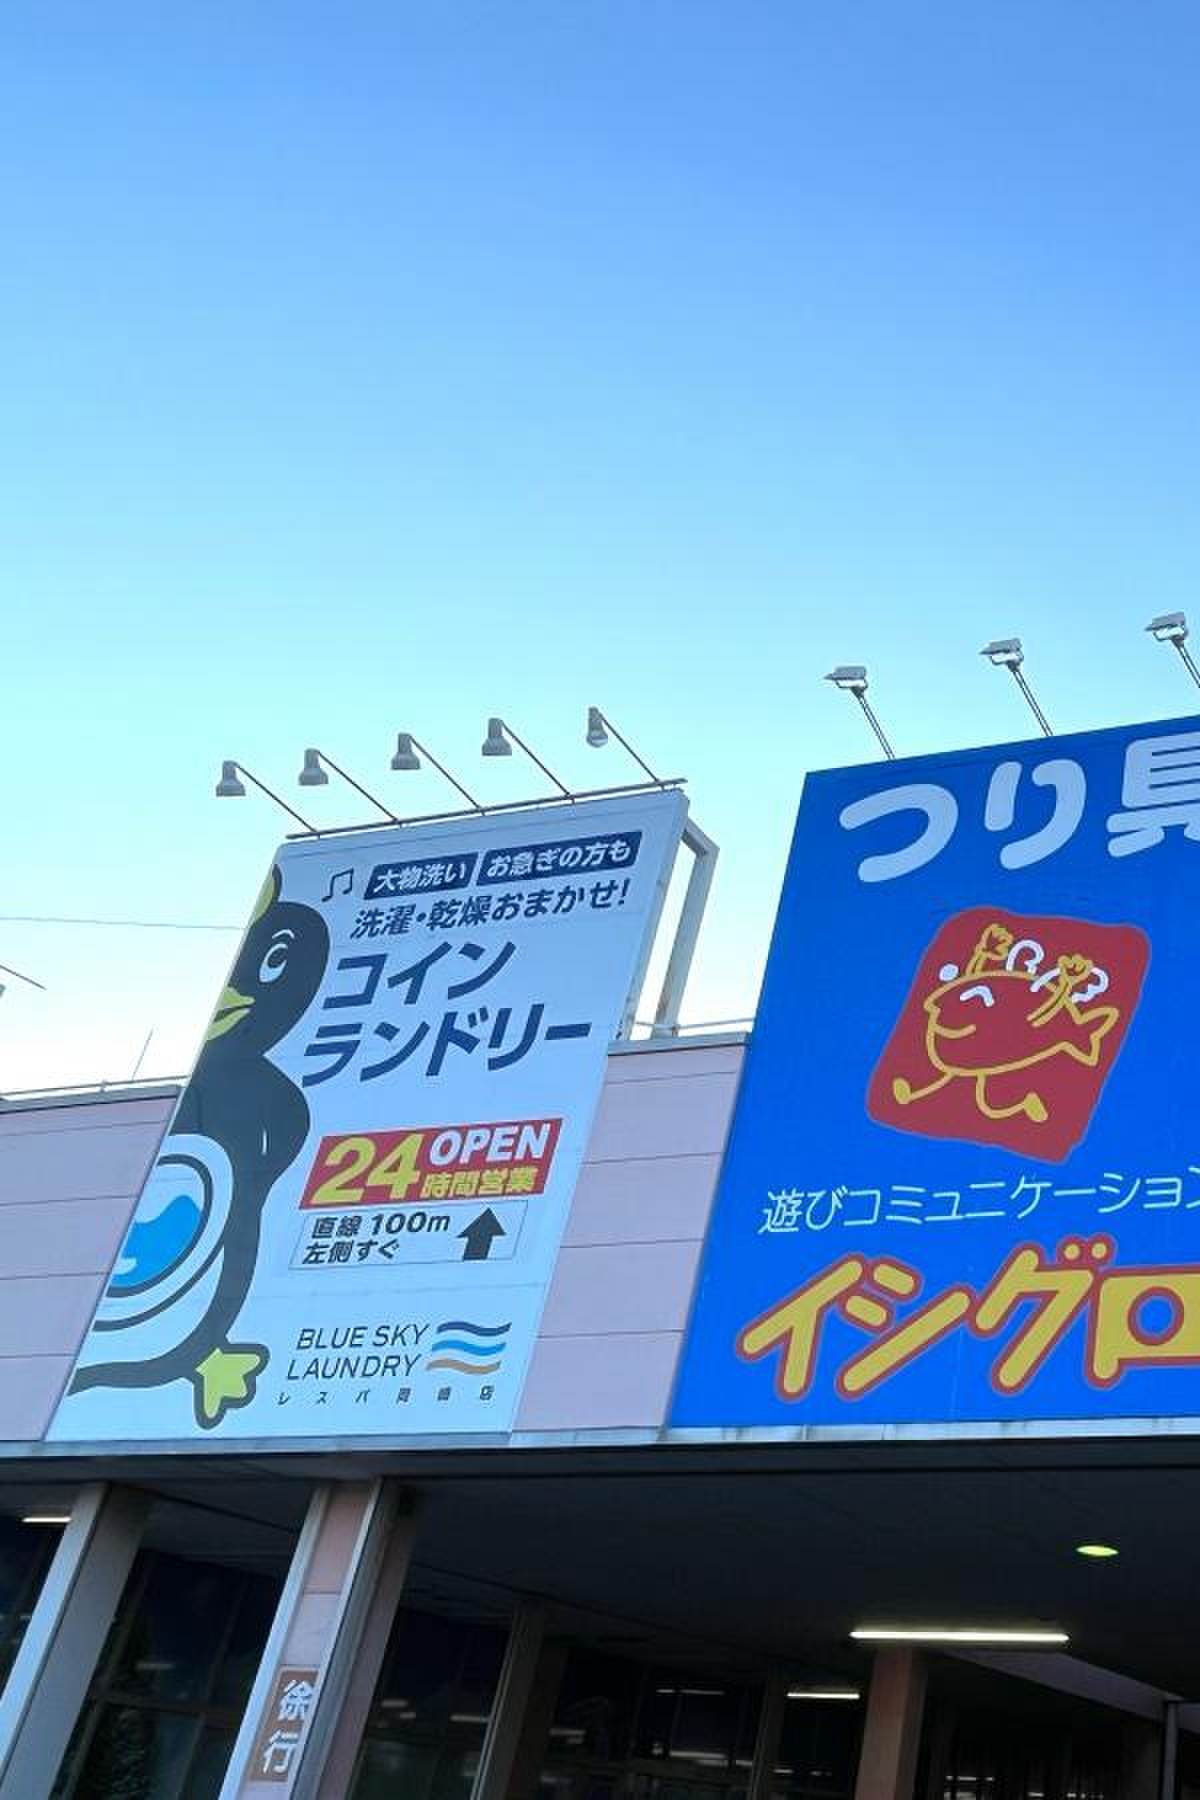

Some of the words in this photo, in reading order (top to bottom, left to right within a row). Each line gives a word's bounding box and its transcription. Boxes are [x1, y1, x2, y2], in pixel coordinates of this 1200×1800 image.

[372, 863, 467, 894] 大物洗い
[487, 838, 632, 878] お急ぎの方も
[322, 941, 516, 1010] コイン
[301, 1003, 593, 1087] ランドリー
[311, 1133, 426, 1205] 24
[419, 1167, 539, 1199] 時間営業
[428, 1123, 551, 1167] OPEN
[311, 1216, 363, 1240] 直線
[370, 1211, 451, 1236] 100m
[302, 1238, 400, 1266] 左側すぐ
[296, 1327, 368, 1350] BLUE
[372, 1323, 430, 1347] SKY
[287, 1354, 421, 1380] LAUNDRY
[262, 1679, 314, 1774] 徐行
